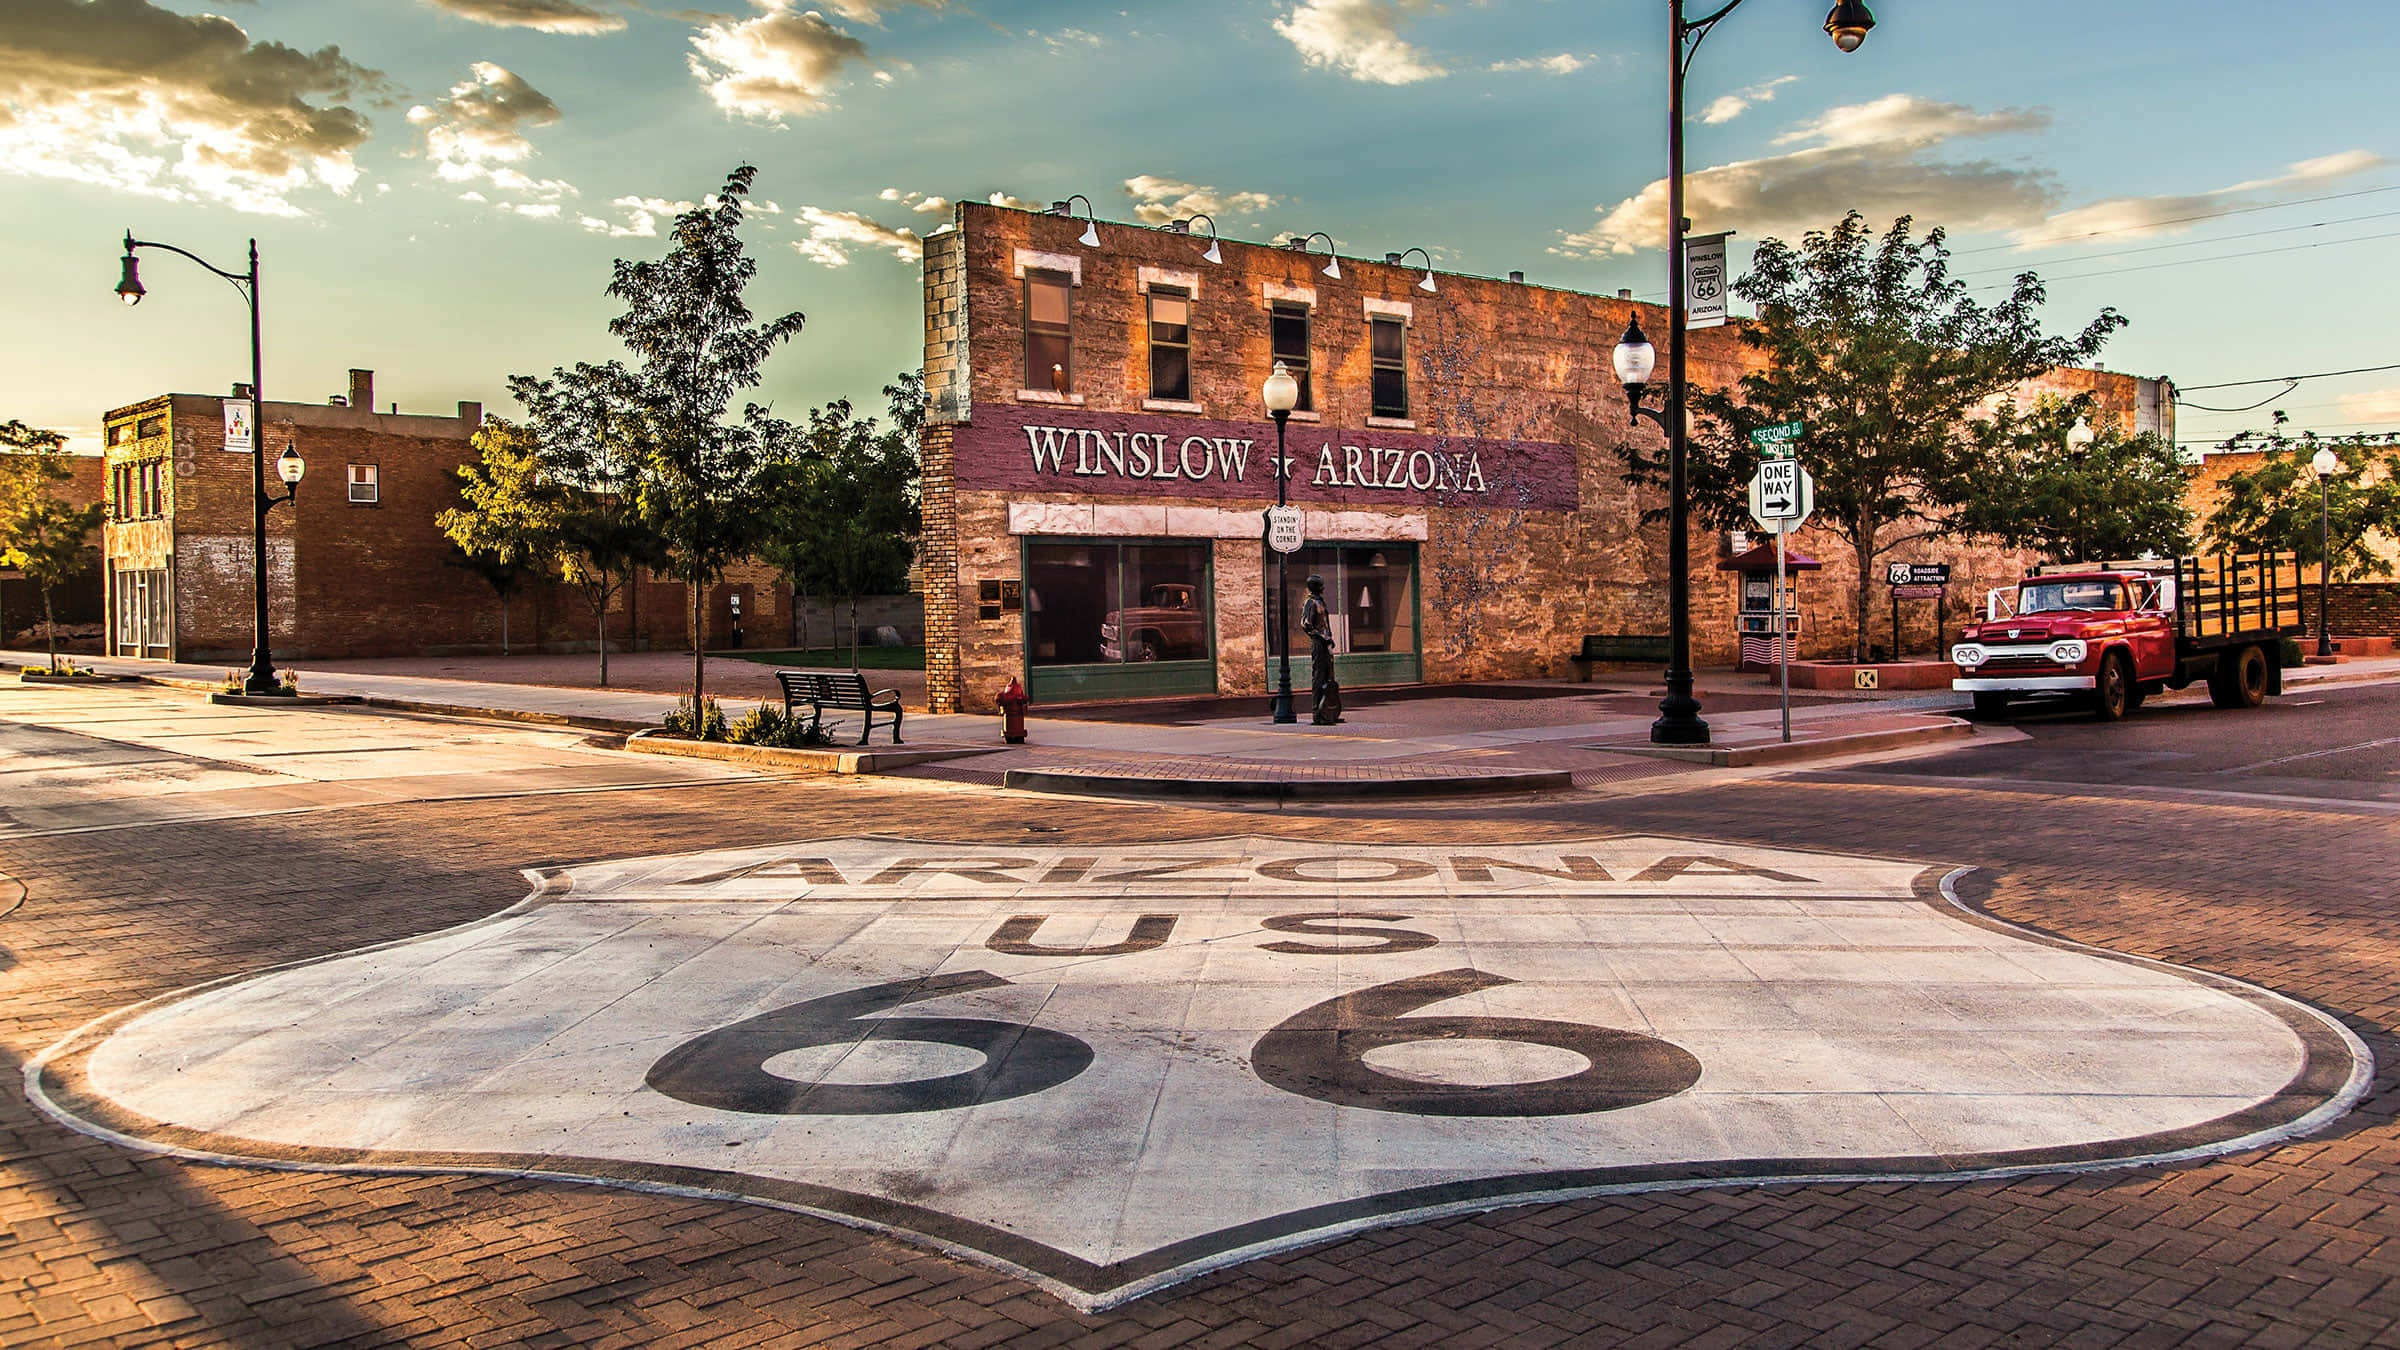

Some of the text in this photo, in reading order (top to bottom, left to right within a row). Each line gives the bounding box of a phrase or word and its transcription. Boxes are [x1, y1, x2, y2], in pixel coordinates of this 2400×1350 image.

[1690, 253, 1723, 262] WINSLOW
[1698, 283, 1715, 296] 66
[1692, 305, 1722, 313] ARIZONA
[1757, 426, 1790, 441] SECOND
[1022, 425, 1487, 493] WINSLOW ARIZONA
[1764, 465, 1791, 480] ONE
[1763, 481, 1792, 495] WAY
[1276, 535, 1296, 543] CORNER
[1893, 570, 1909, 582] 66
[676, 856, 1819, 886] ARIZONA
[985, 912, 1439, 957] US
[644, 967, 1702, 1117] 66
